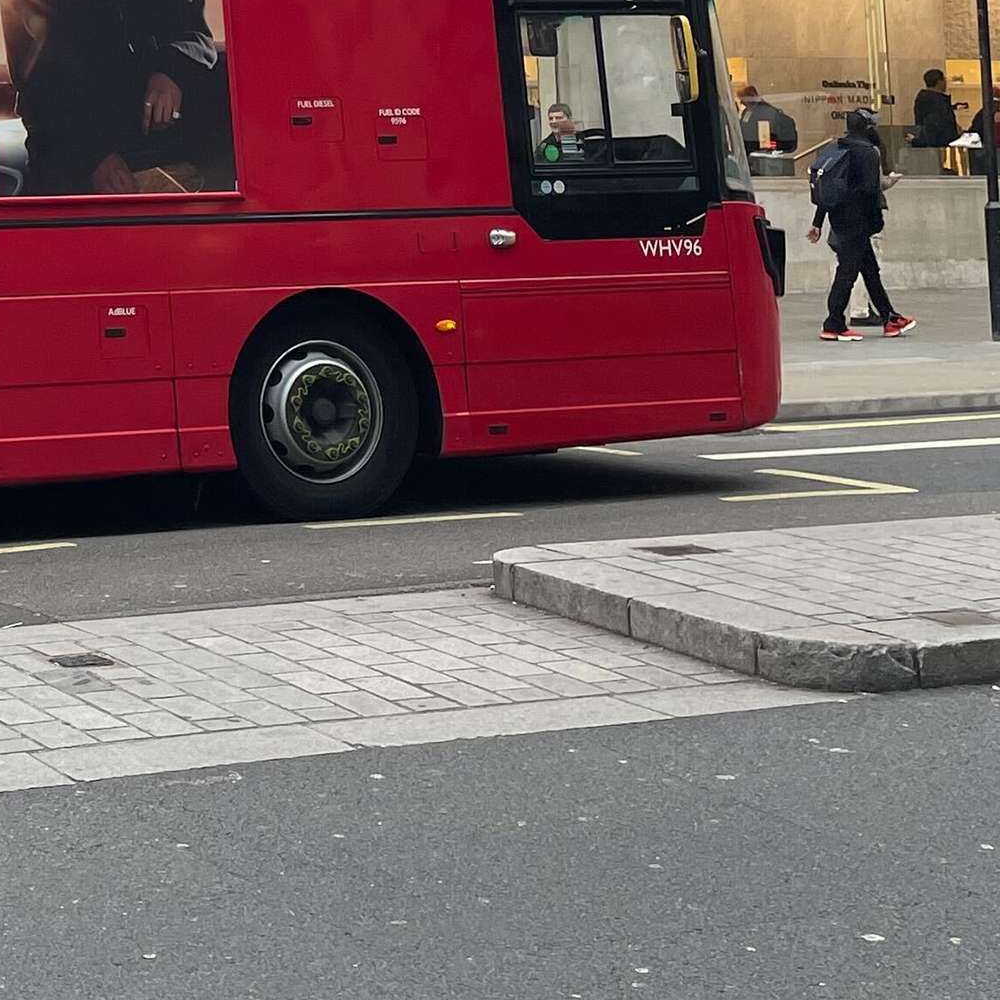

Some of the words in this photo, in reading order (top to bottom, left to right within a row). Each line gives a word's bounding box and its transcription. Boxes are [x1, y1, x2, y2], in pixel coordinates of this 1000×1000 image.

[297, 100, 312, 108] FUEL
[313, 100, 334, 108] DIESEL
[379, 108, 394, 116] FUEL
[394, 108, 401, 116] ID
[402, 108, 420, 116] CODE
[639, 239, 703, 257] WHV96
